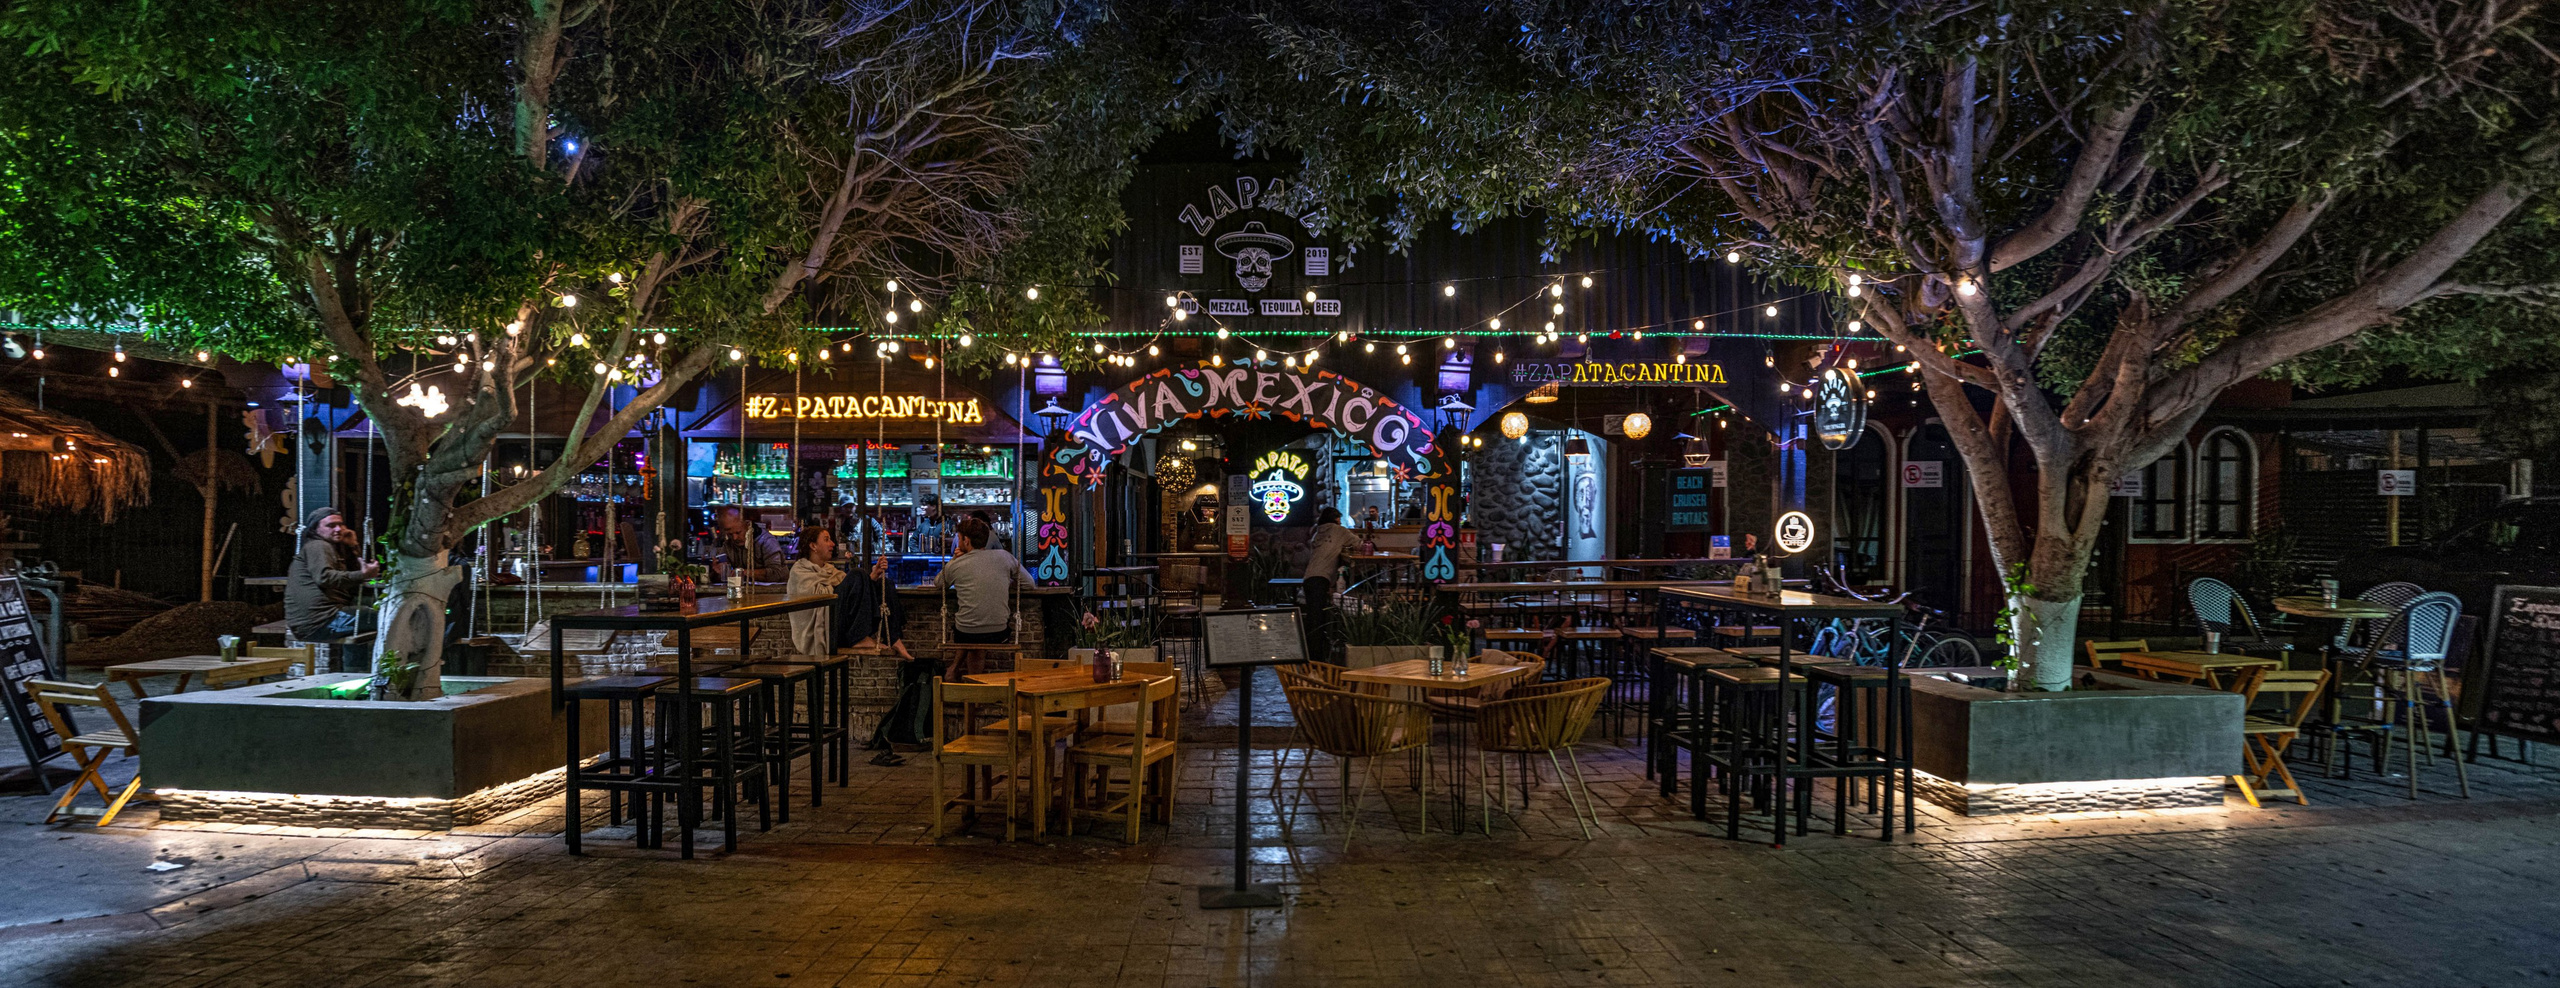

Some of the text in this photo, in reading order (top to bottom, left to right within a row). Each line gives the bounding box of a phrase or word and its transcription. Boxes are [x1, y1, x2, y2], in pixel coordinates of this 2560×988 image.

[1182, 247, 1202, 256] EST.
[1306, 249, 1327, 258] 2019
[1211, 301, 1247, 313] MEZCAL
[1262, 301, 1301, 313] TEQUILA
[1316, 301, 1339, 312] BEER
[1513, 362, 1728, 384] #ZAPATACANTINA
[1074, 368, 1410, 452] VIVA MEXICO
[1677, 476, 1703, 489] BEACH
[1673, 493, 1706, 507] CRUISER
[1672, 512, 1708, 525] RENTALS
